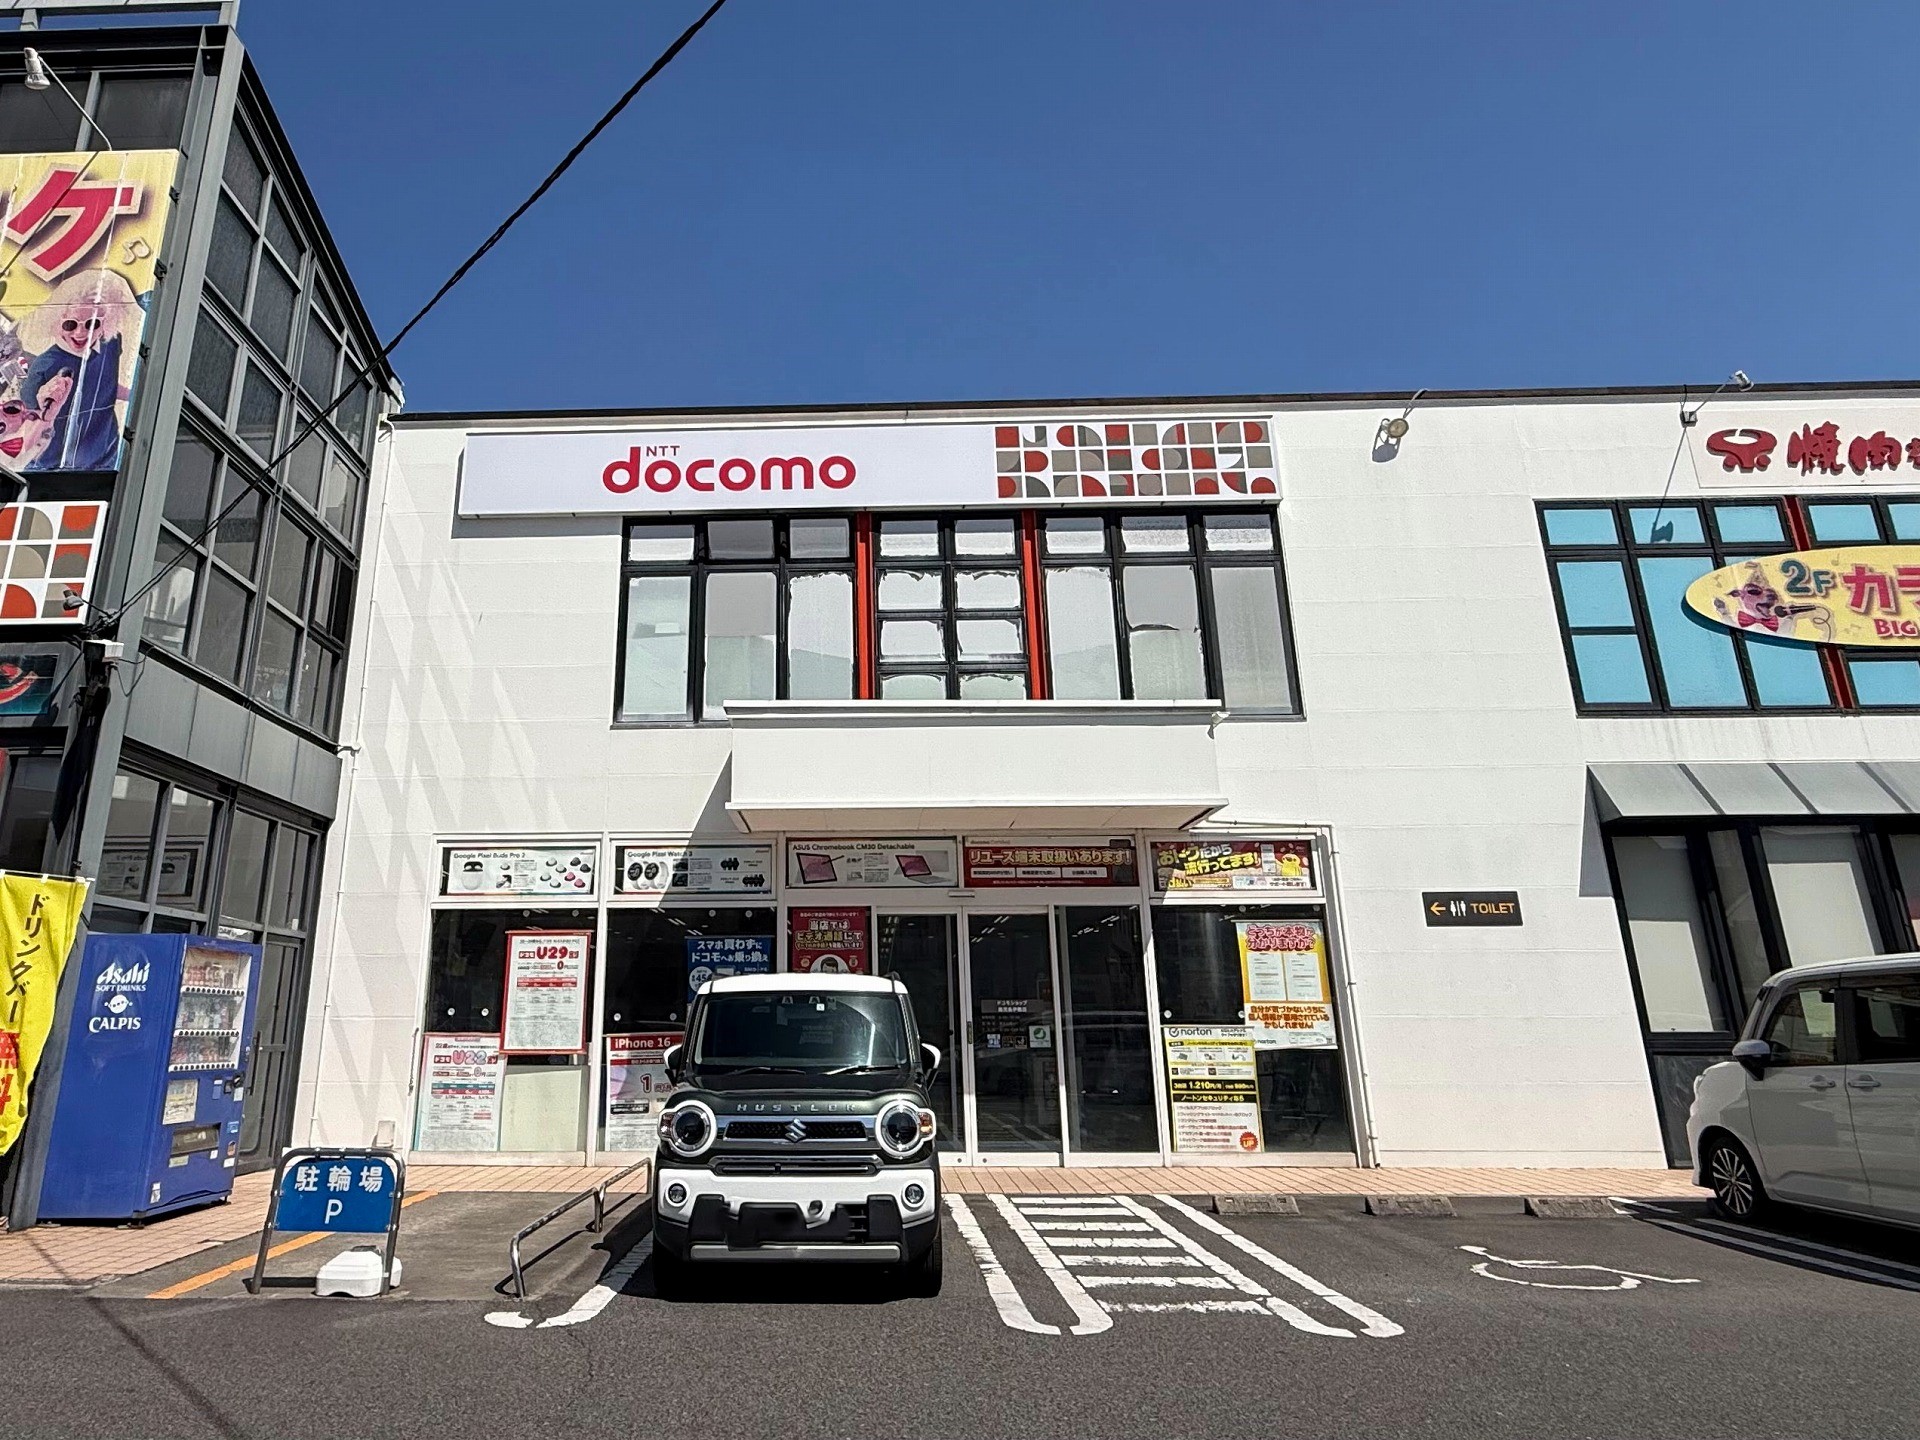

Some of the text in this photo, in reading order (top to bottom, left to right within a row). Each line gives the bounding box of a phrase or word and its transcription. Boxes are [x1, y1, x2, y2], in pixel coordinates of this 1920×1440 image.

[645, 445, 681, 458] NTT
[1787, 421, 1920, 476] 焼肉
[602, 446, 857, 494] docomo
[1781, 559, 1834, 596] 2F
[1874, 618, 1918, 637] BIG
[1470, 903, 1515, 914] TOILET
[697, 938, 763, 951] スマホ買わずに
[5, 893, 50, 1023] ドリンクバー
[536, 946, 569, 960] U29
[691, 950, 769, 963] ドコモへお乗り換え
[95, 962, 152, 986] Asahi
[95, 984, 147, 992] SOFT DRINKS
[88, 1017, 142, 1034] CALPIS
[1180, 1027, 1212, 1036] norton
[614, 1037, 671, 1049] iPhone 16
[452, 1050, 487, 1065] U22
[736, 1103, 857, 1112] HUSTLER
[1243, 1140, 1255, 1148] UP
[294, 1165, 384, 1193] 駐輪場
[324, 1199, 343, 1224] P
